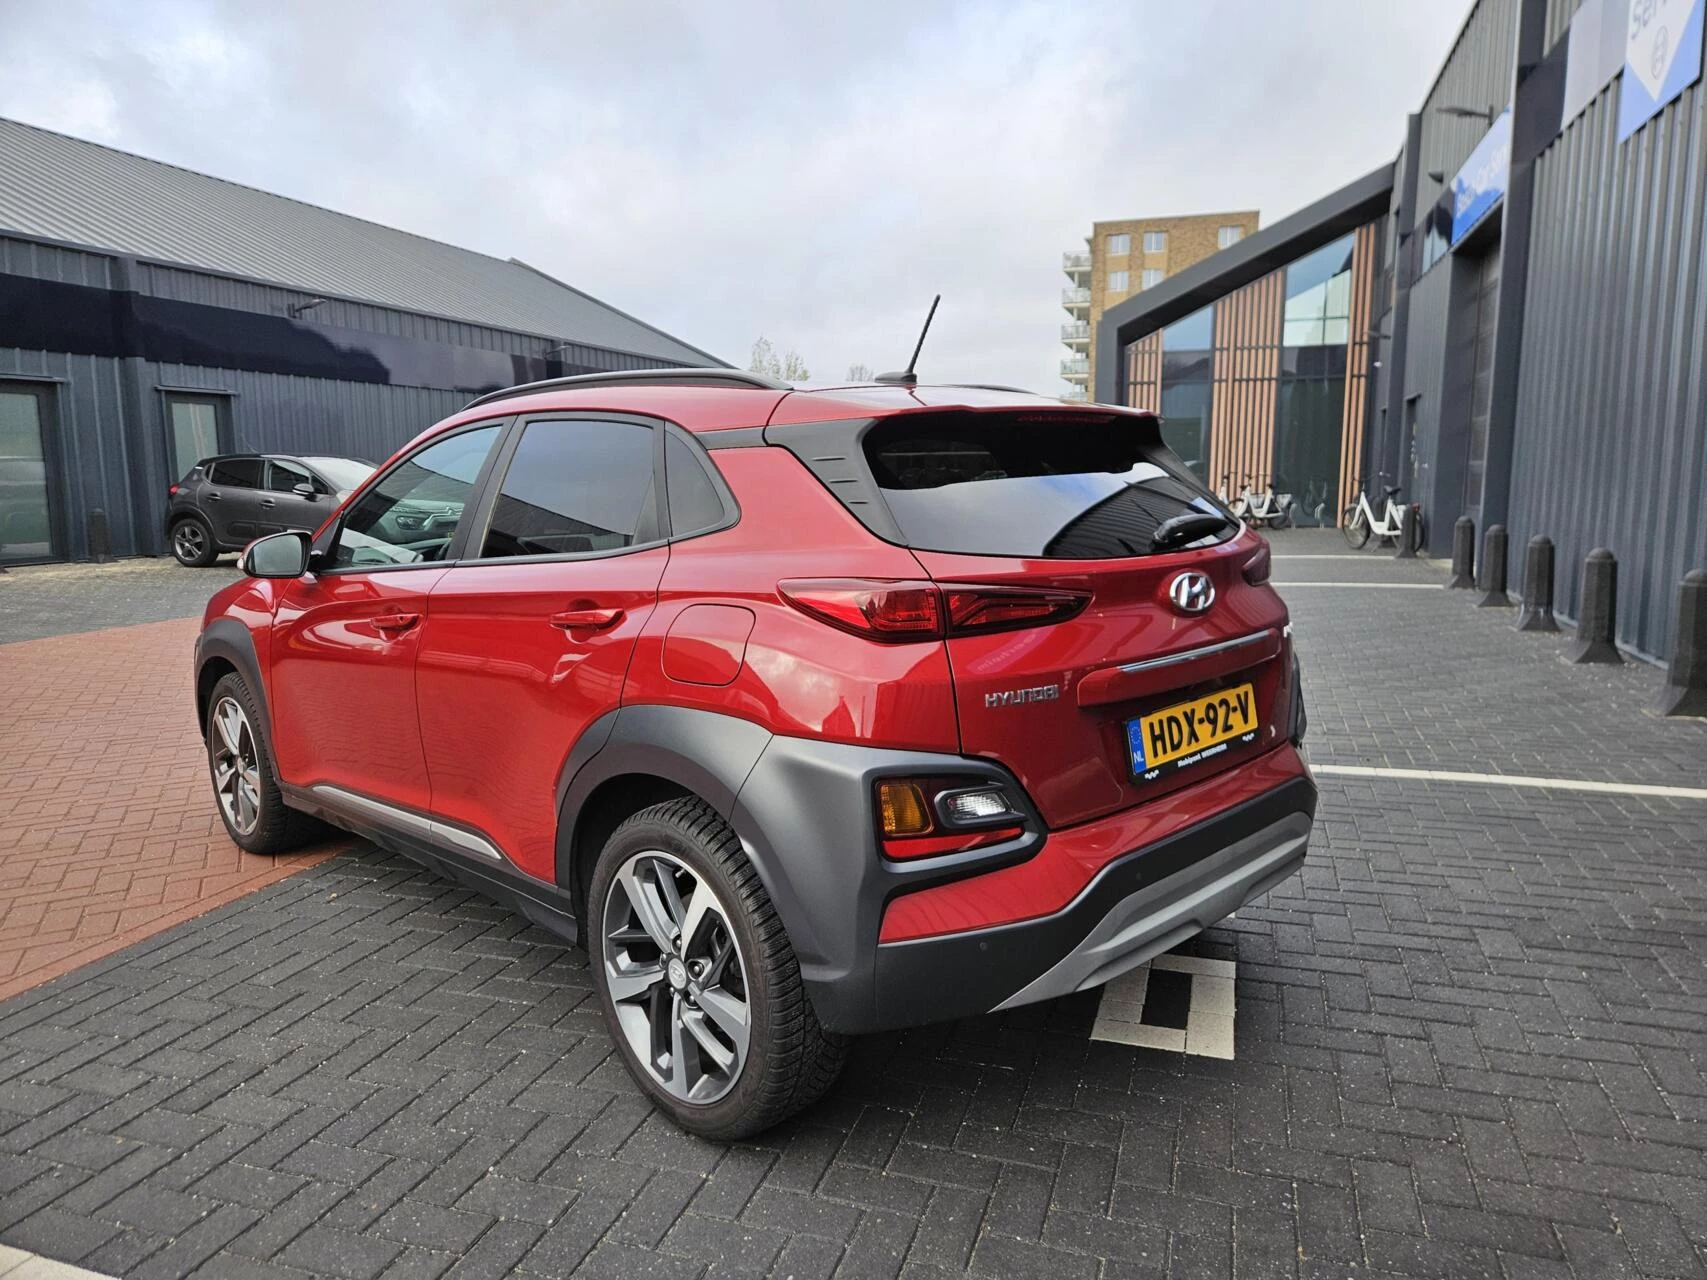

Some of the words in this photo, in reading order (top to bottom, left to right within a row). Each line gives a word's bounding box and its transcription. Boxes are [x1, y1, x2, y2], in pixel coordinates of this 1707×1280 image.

[985, 684, 1059, 708] HYUNDAI
[1149, 690, 1249, 758] HDX-92-V
[1133, 750, 1144, 763] NL
